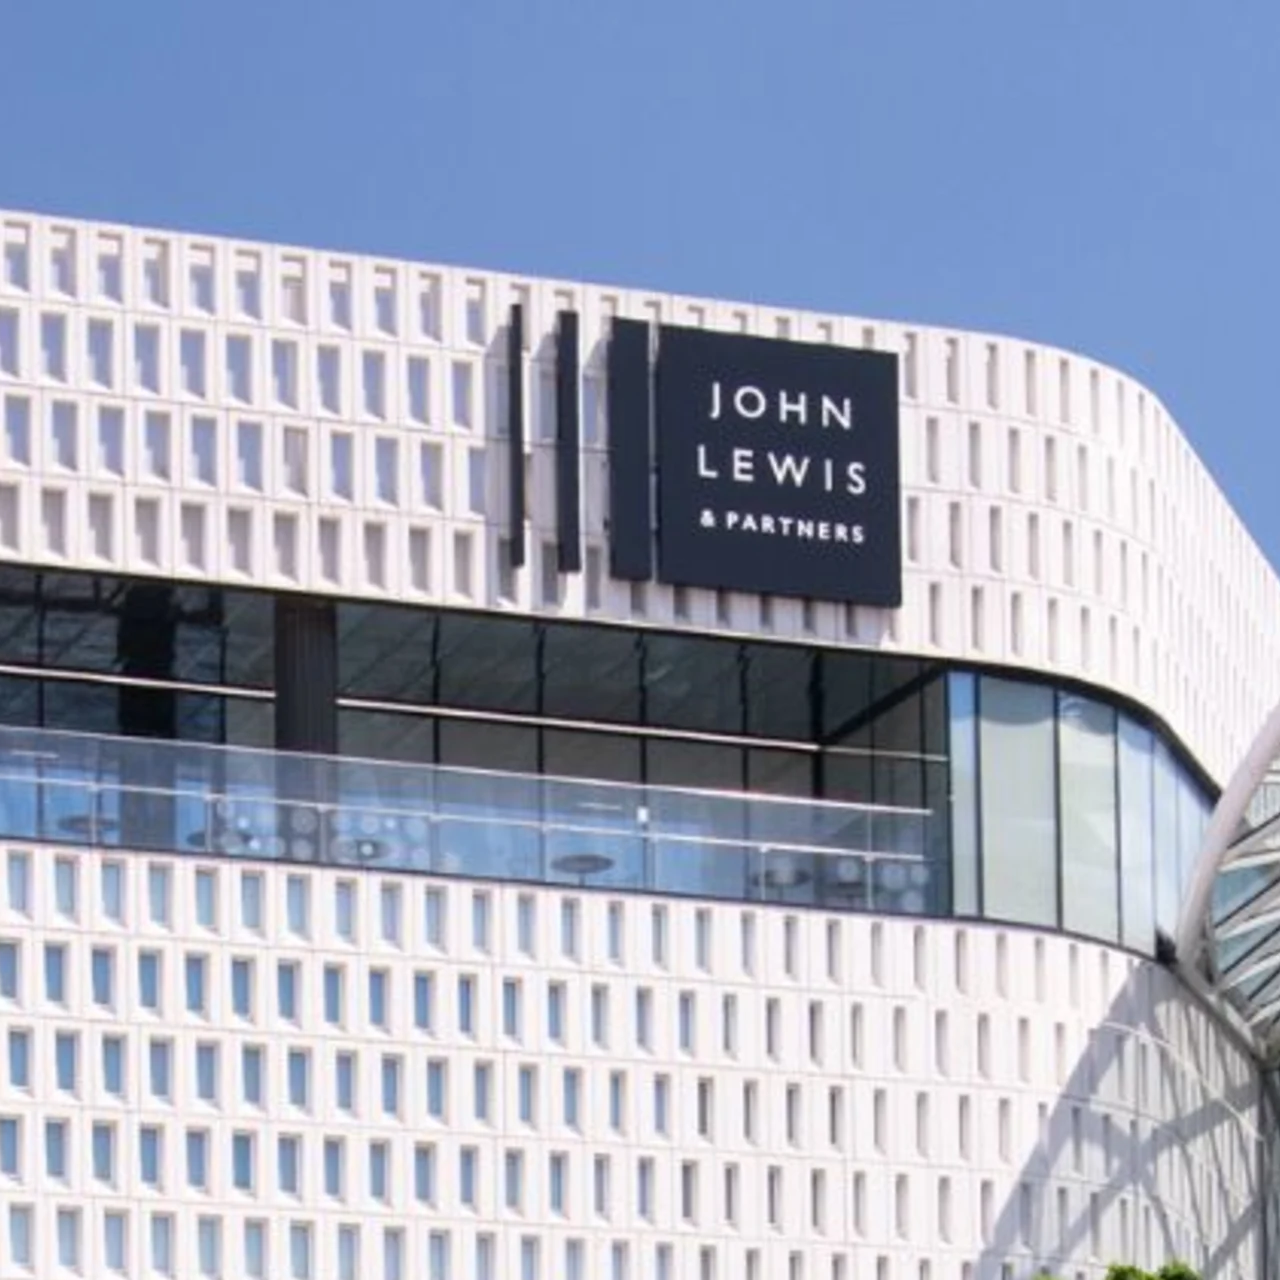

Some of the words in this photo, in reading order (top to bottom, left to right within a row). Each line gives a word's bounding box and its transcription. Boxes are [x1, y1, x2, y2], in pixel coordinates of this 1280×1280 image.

[709, 382, 852, 430] JOHN
[697, 445, 867, 495] LEWIS
[699, 509, 714, 528] &
[726, 511, 864, 543] PARTNERS
